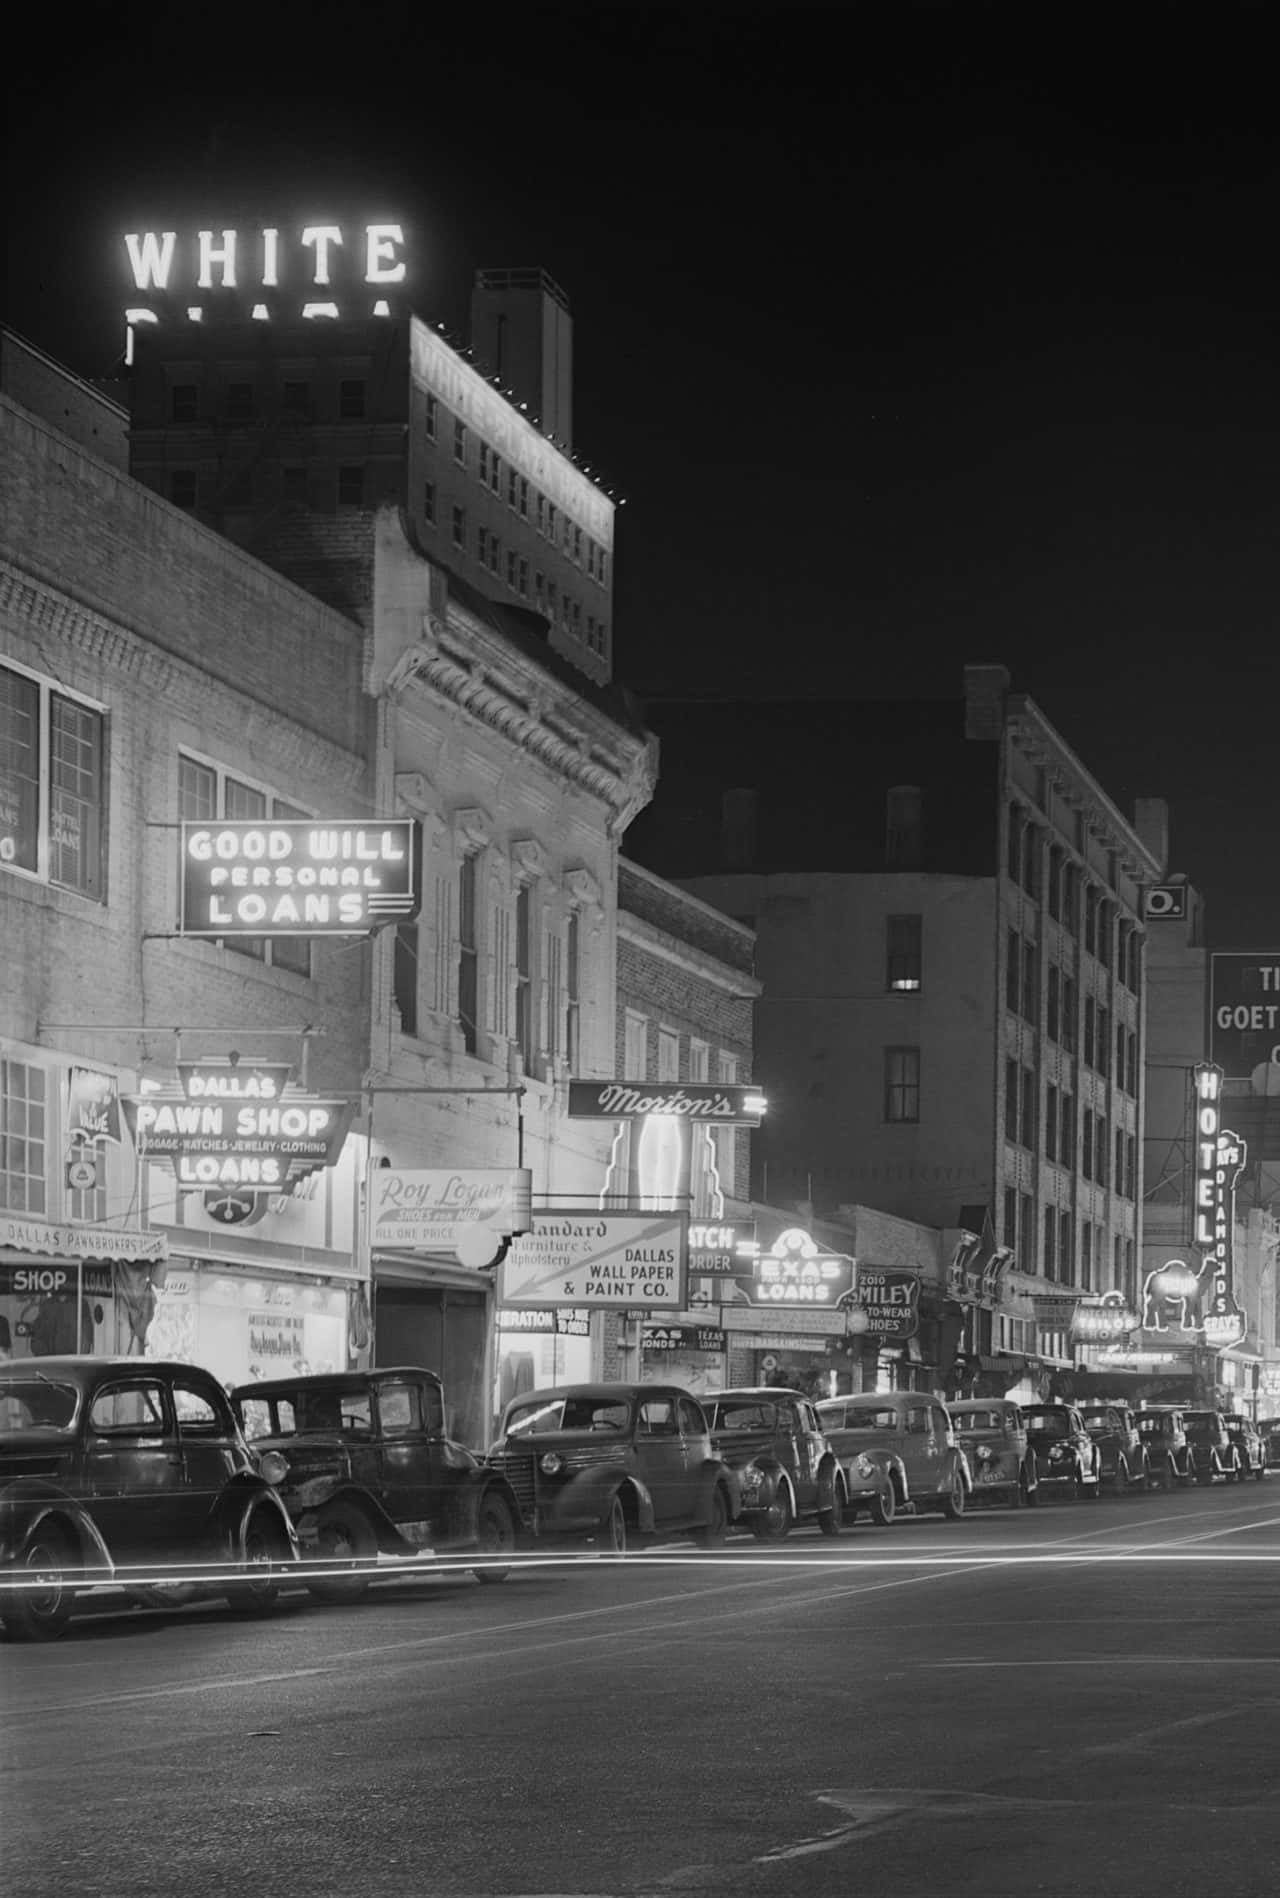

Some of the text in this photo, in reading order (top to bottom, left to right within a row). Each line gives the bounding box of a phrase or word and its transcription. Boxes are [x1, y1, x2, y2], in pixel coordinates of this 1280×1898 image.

[124, 224, 406, 290] WHITE
[188, 830, 404, 860] GOOD WILL
[210, 867, 381, 887] PERSONAL
[209, 893, 363, 923] LOANS
[1145, 890, 1181, 914] O.
[188, 1075, 277, 1099] DALLAS
[598, 1085, 737, 1116] Morton's
[136, 1104, 330, 1137] PAWN SHOP
[280, 1142, 327, 1152] CLOTHING
[1199, 1071, 1218, 1243] HOTEL
[178, 1156, 281, 1183] LOANS
[380, 1176, 431, 1207] Roy
[398, 1209, 433, 1222] SHOES
[8, 1223, 60, 1246] DALLAS
[688, 1226, 735, 1249] ATCH
[513, 1240, 580, 1253] Furniture
[624, 1248, 675, 1263] DALLAS
[13, 1269, 67, 1291] SHOP
[589, 1265, 674, 1281] WALL PAPER
[753, 1259, 842, 1279] EXAS
[563, 1281, 670, 1298] & PAINT CO.
[757, 1284, 830, 1301] LOANS
[500, 1310, 553, 1327] ERATION
[866, 1320, 901, 1331] HOES
[641, 1329, 683, 1340] XAS
